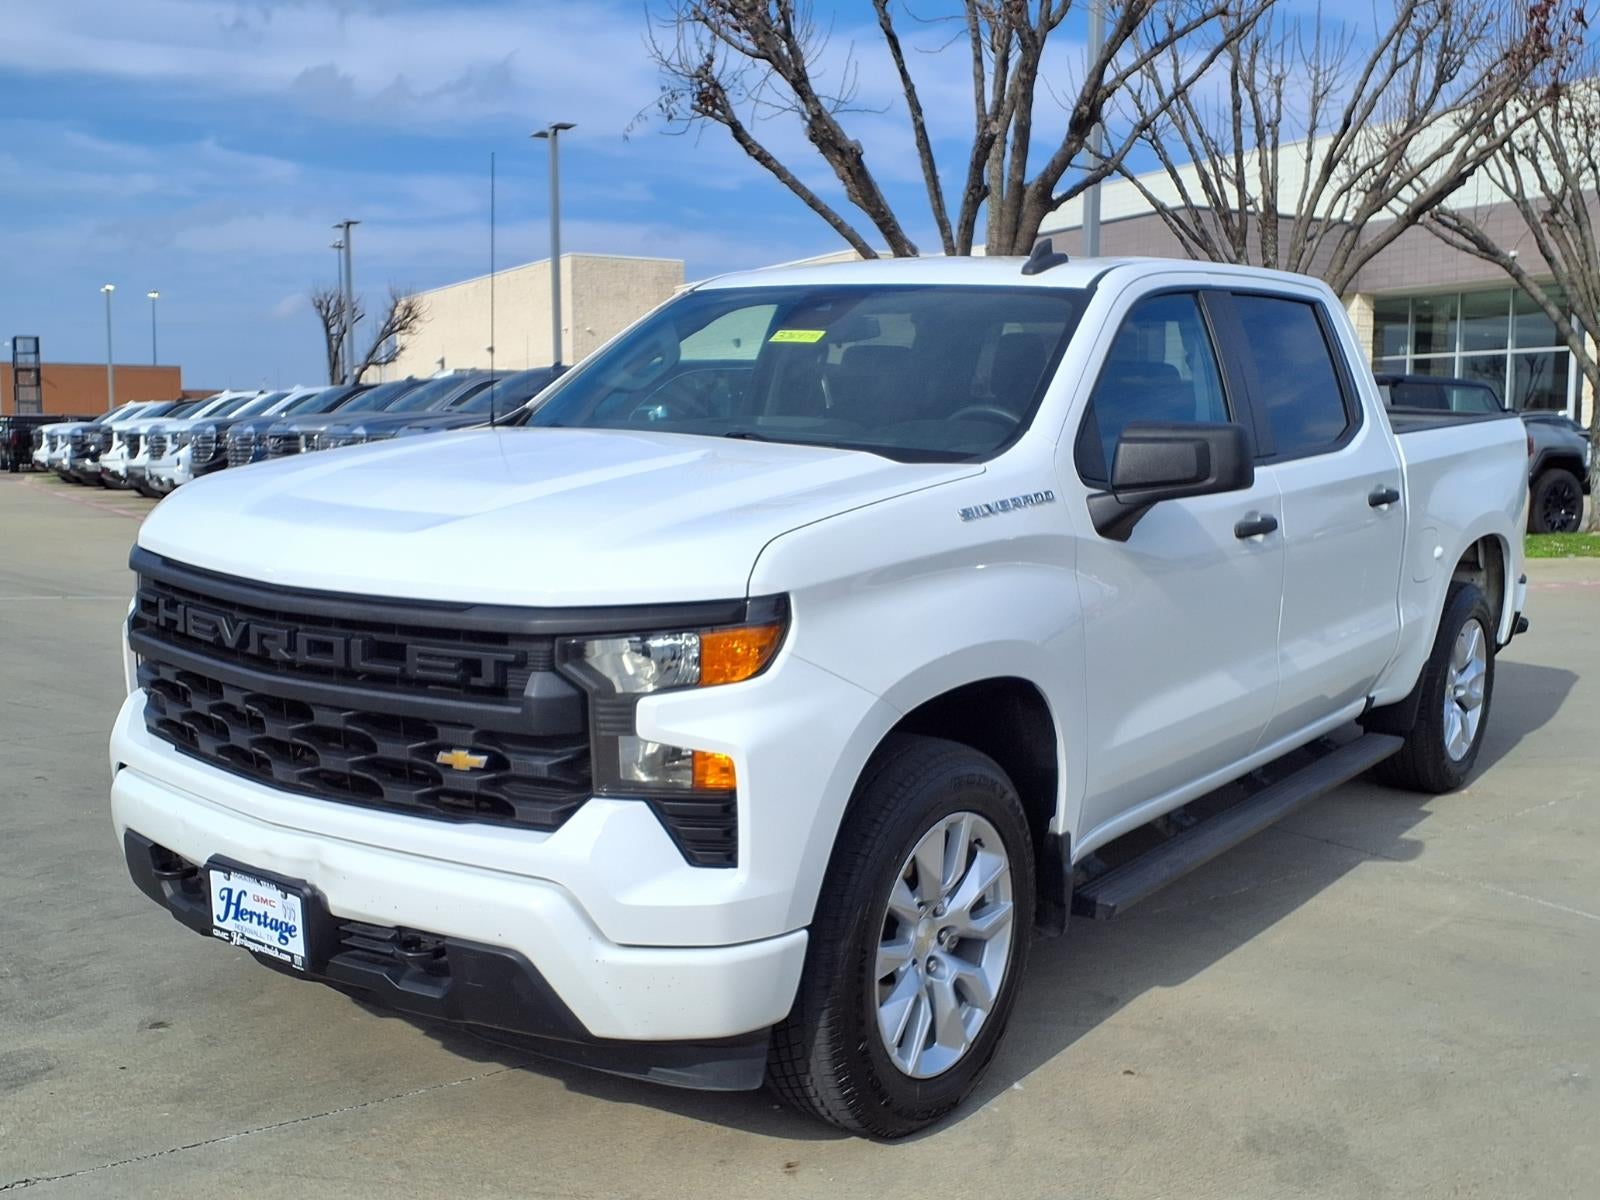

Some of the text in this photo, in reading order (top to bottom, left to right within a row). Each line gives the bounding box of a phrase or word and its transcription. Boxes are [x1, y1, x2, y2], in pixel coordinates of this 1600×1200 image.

[958, 489, 1056, 522] SILVERADO
[136, 588, 525, 685] CHEVROLET
[216, 887, 297, 946] Heritage
[253, 894, 276, 908] GMC
